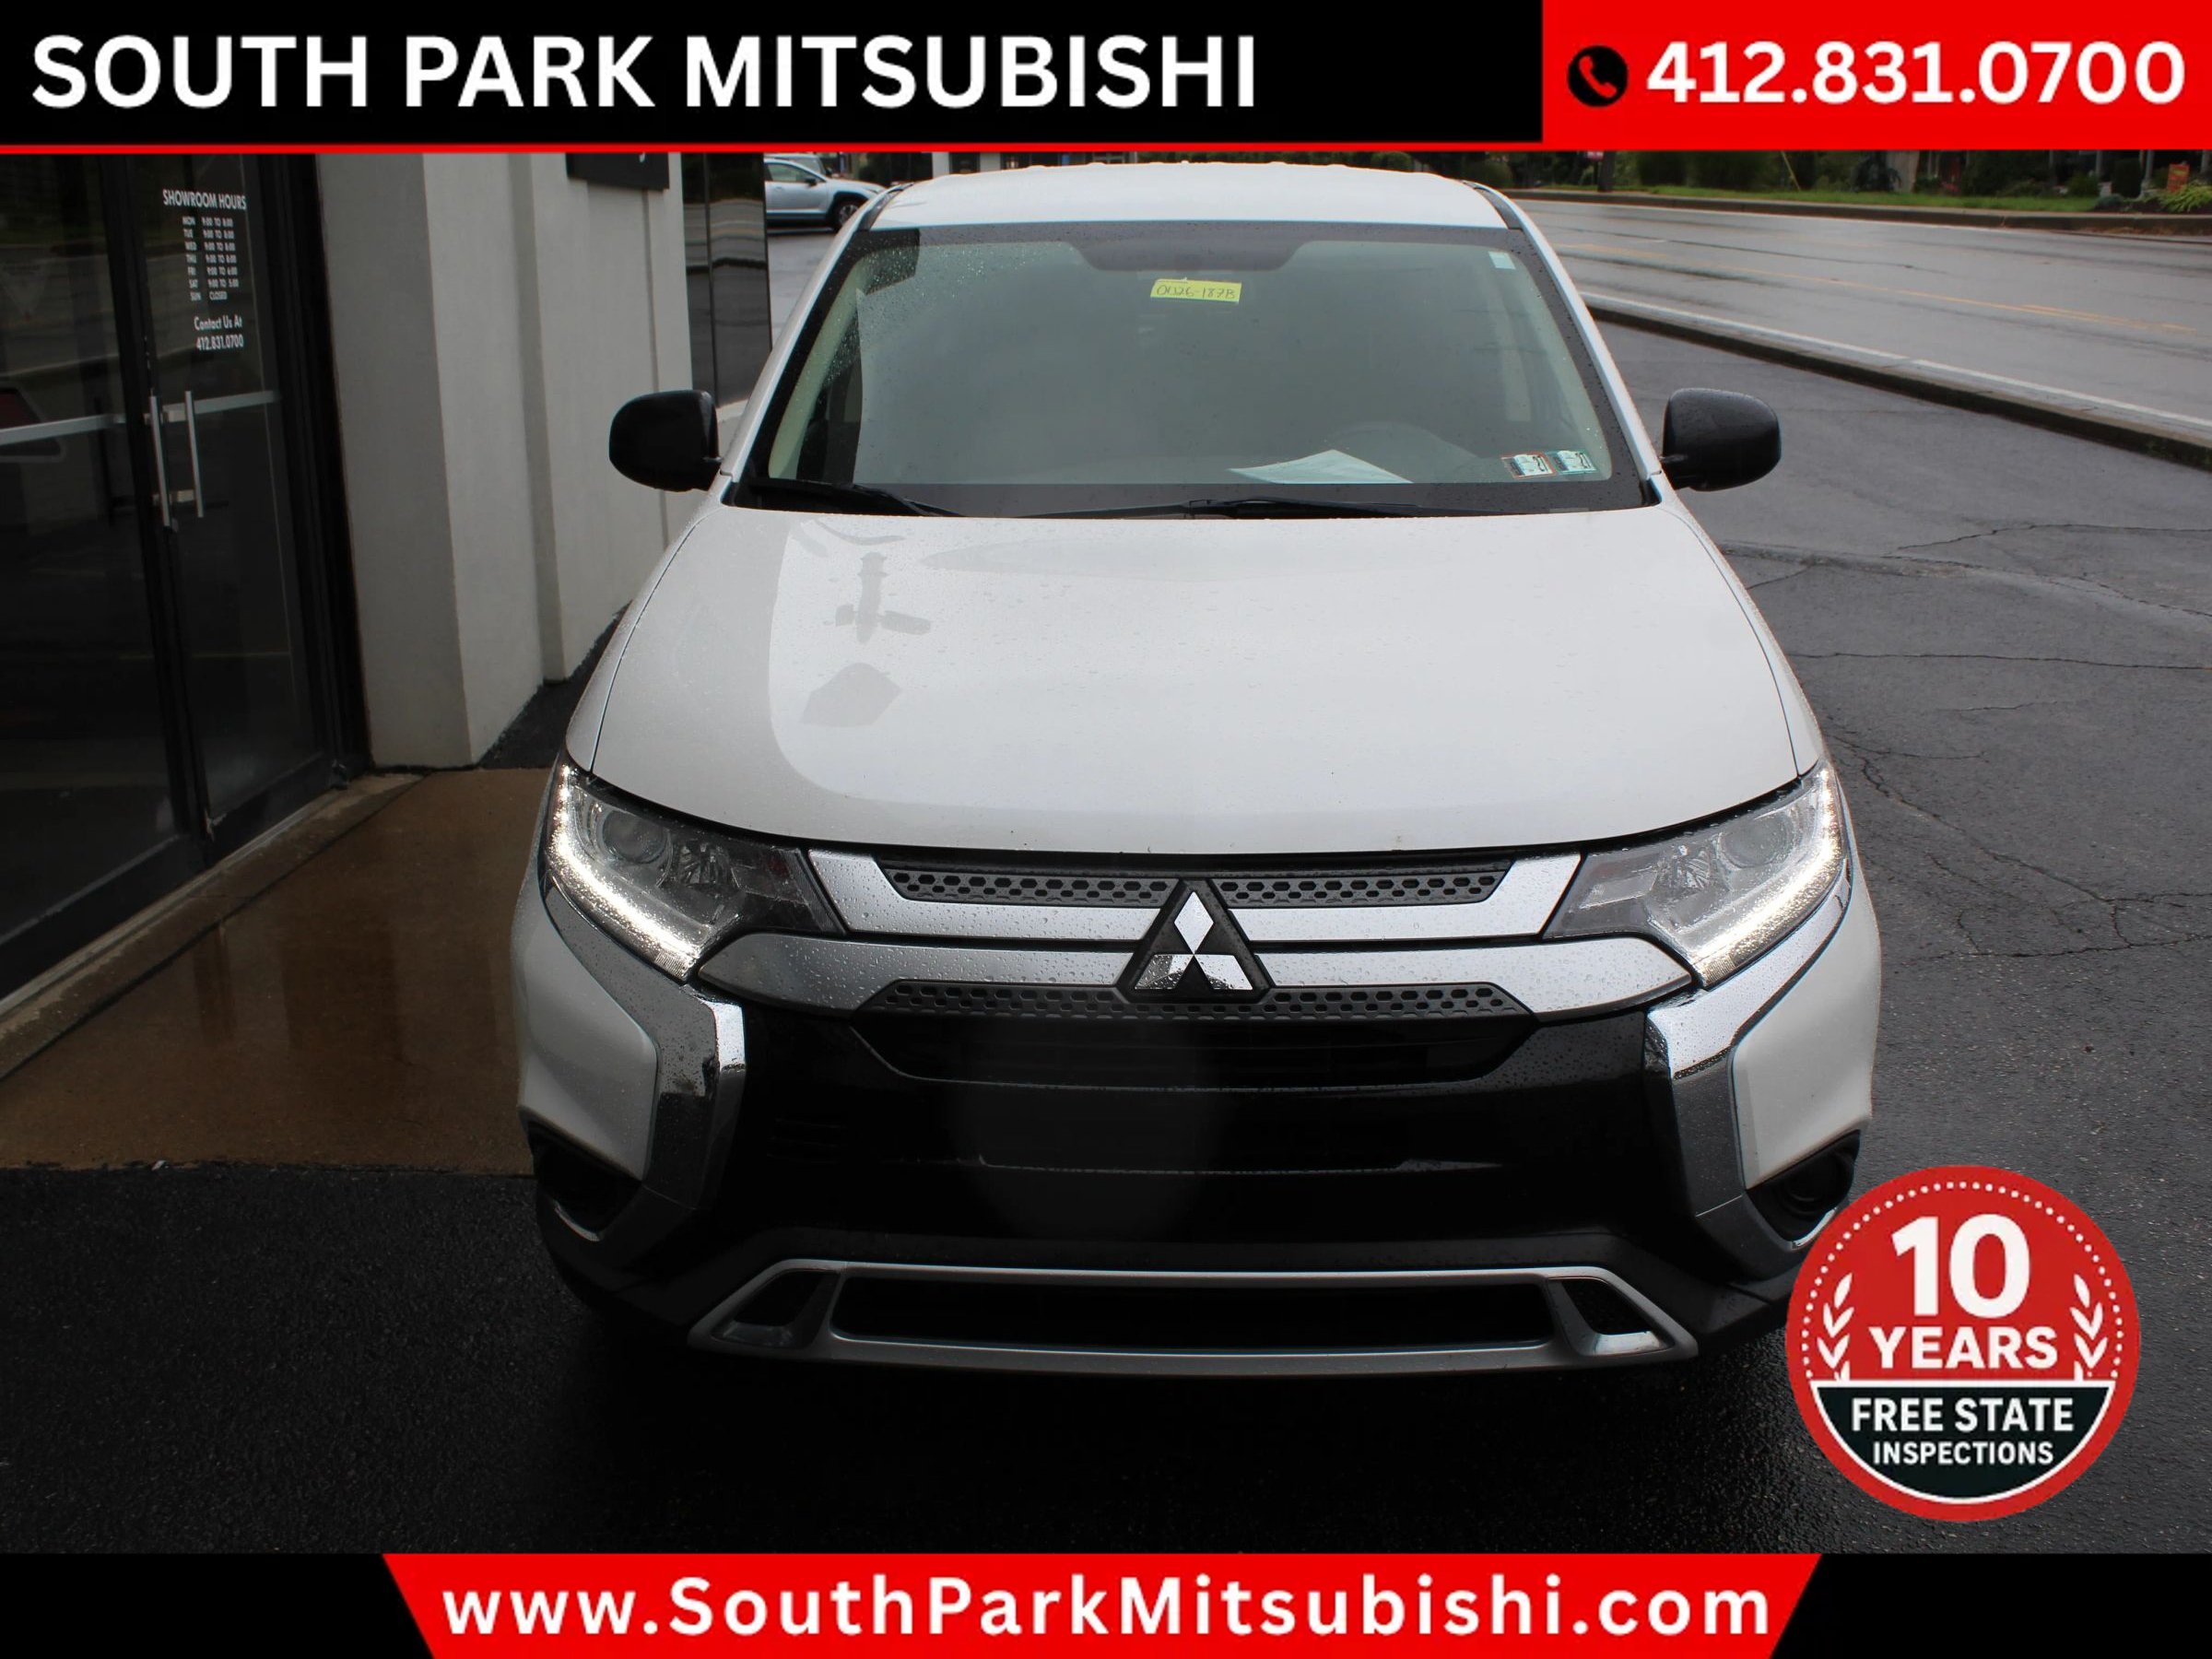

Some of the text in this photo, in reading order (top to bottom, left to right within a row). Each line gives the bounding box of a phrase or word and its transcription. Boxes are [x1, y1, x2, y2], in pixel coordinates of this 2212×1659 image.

[163, 189, 246, 210] SHOWROOM HOURS
[209, 291, 228, 300] CLOSED
[194, 314, 242, 330] Contact Us At
[196, 334, 244, 350] 412.831.0700
